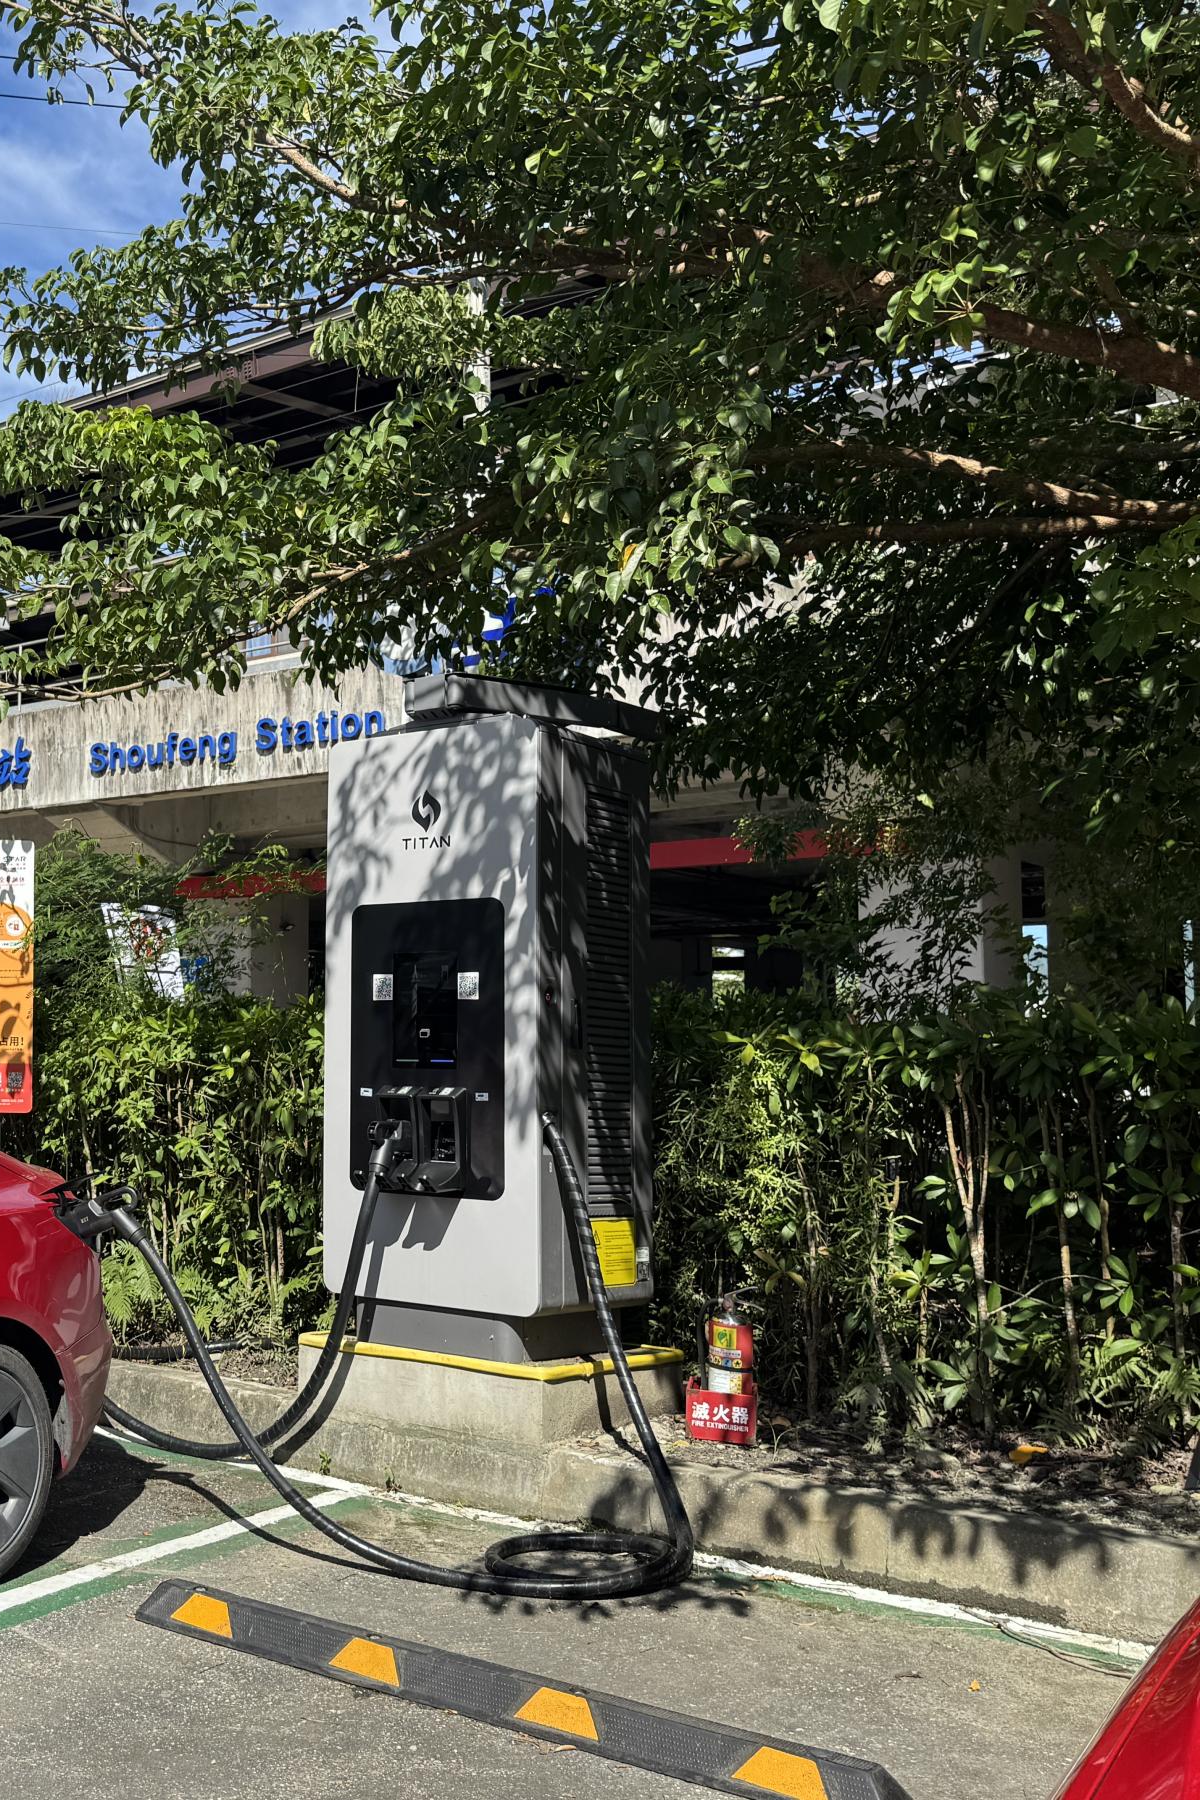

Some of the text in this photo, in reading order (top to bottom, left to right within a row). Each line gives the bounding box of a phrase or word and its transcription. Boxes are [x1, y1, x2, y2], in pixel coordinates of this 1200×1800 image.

[90, 710, 386, 773] Shoufeng Station
[402, 835, 450, 850] TITAN
[691, 1401, 749, 1425] 滅火器
[691, 1420, 749, 1432] FIRE EXTINGUISHER
